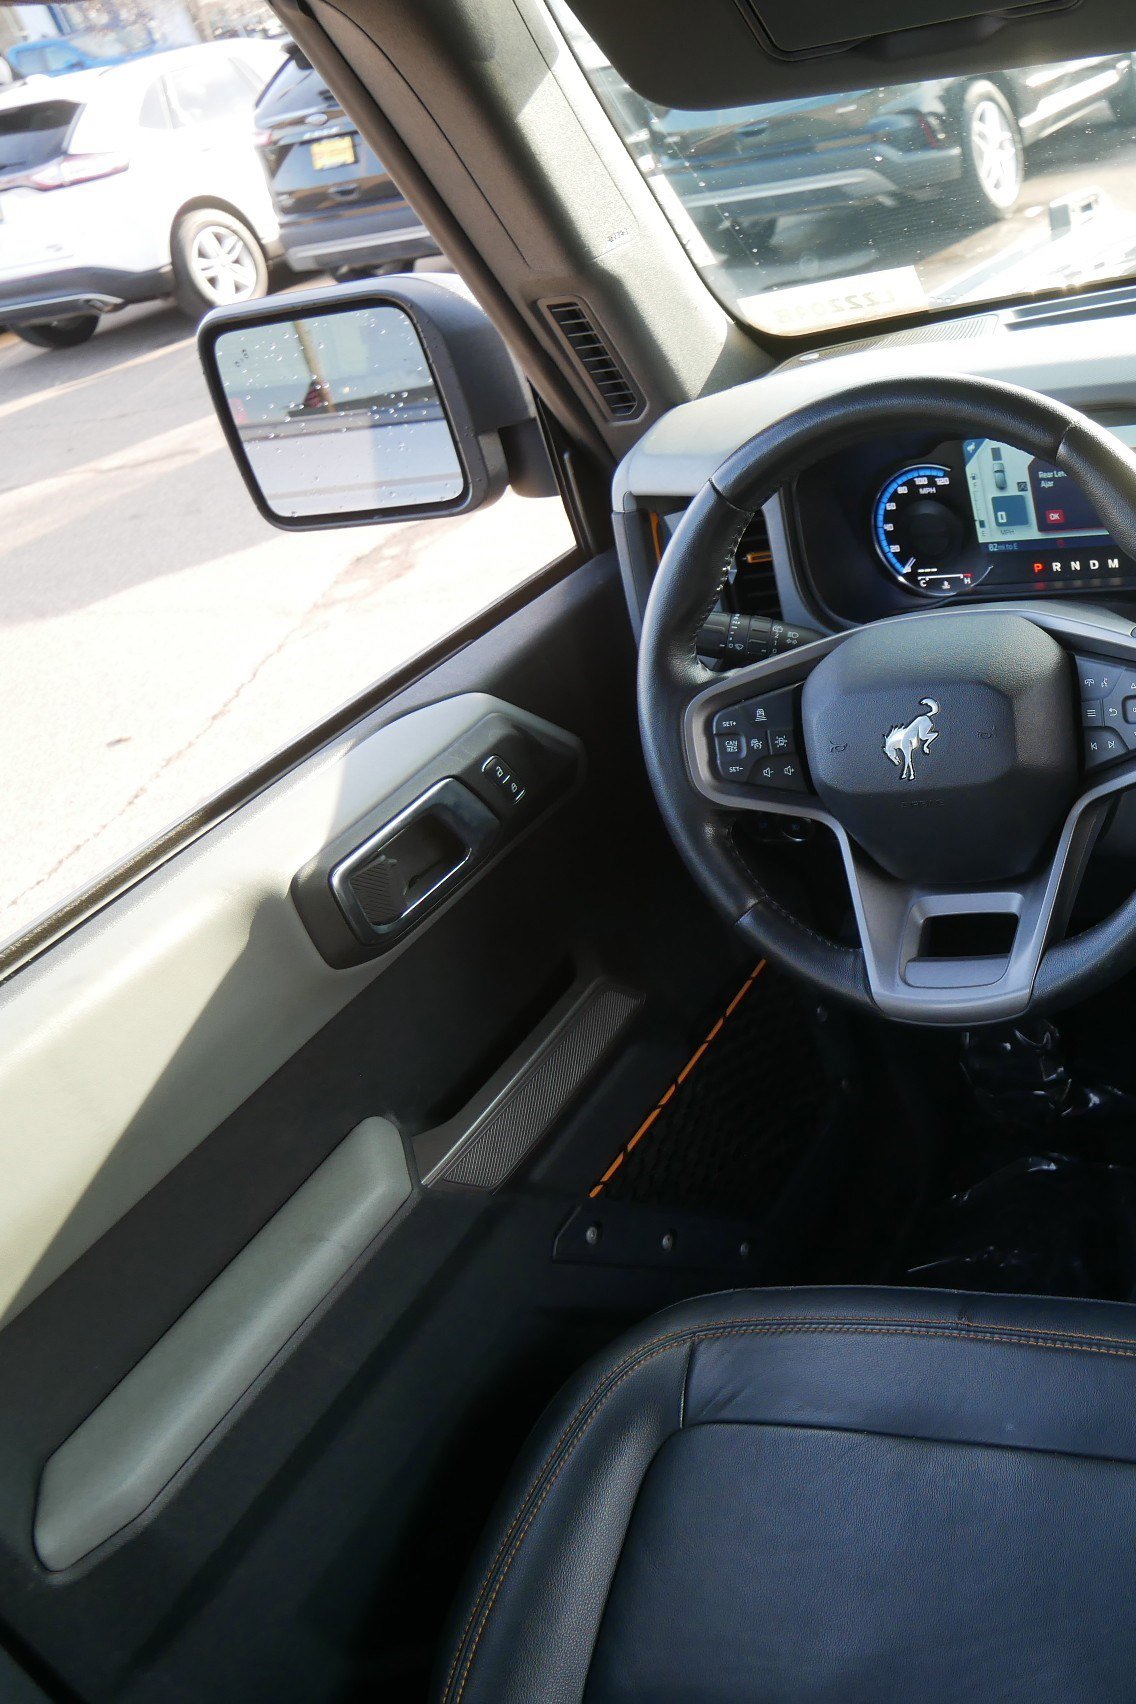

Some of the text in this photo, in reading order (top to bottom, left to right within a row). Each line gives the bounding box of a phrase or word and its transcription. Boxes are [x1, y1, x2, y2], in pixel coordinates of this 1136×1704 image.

[1038, 471, 1053, 479] Rear
[1040, 480, 1054, 488] Ajar
[886, 502, 896, 510] 60
[1049, 512, 1060, 520] OK
[890, 545, 900, 553] 20
[1033, 558, 1119, 573] P R N D M
[722, 720, 737, 728] SET+
